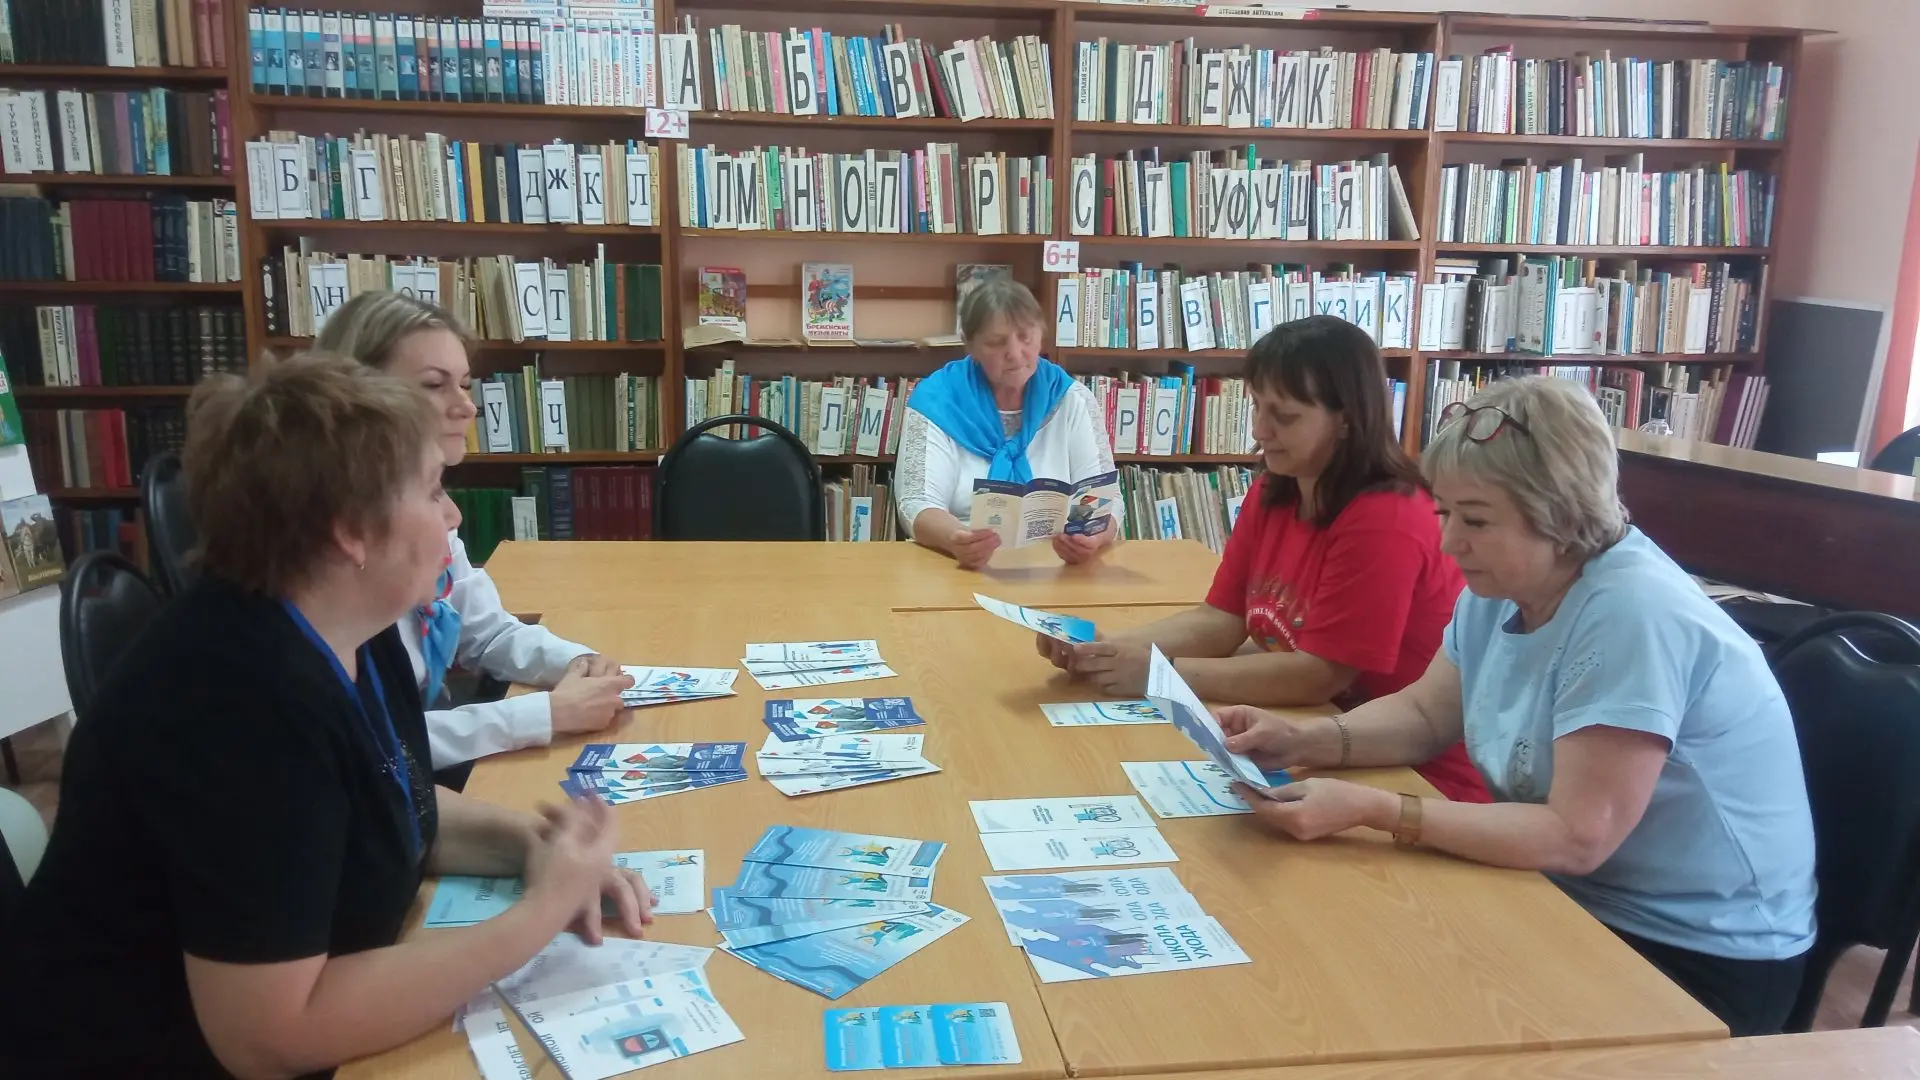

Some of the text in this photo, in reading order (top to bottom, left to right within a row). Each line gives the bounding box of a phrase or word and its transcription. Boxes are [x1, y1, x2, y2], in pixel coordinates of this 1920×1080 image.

[679, 39, 698, 104] А
[794, 45, 810, 109] Б
[891, 50, 912, 114] В
[950, 52, 968, 117] Г
[1134, 54, 1154, 119] Д
[1203, 60, 1222, 113] Е
[1228, 60, 1251, 115] Ж
[1276, 62, 1298, 122] И
[1309, 63, 1330, 123] К
[646, 113, 687, 134] 12+
[280, 159, 299, 191] Б
[358, 168, 376, 199] Г
[526, 171, 542, 202] Д
[547, 169, 569, 190] Ж
[584, 172, 602, 204] К
[630, 174, 648, 205] Л
[714, 161, 731, 222] Л
[795, 160, 812, 225] Н
[736, 163, 757, 224] М
[843, 166, 863, 228] О
[879, 168, 898, 228] П
[978, 169, 994, 229] Р
[1074, 170, 1093, 229] С
[1147, 175, 1163, 230] Т
[1210, 175, 1228, 232] У
[1227, 178, 1248, 234] Ф
[1266, 174, 1281, 225] Ч
[1289, 176, 1309, 227] Ш
[1337, 178, 1354, 229] Я
[1046, 245, 1077, 266] 6+
[325, 286, 345, 306] Н
[524, 284, 541, 316] С
[549, 290, 565, 320] Т
[1059, 294, 1074, 323] А
[1140, 298, 1154, 326] Б
[1185, 300, 1201, 327] В
[1356, 300, 1371, 327] И
[1388, 294, 1403, 323] К
[1254, 301, 1270, 329] Г
[488, 403, 503, 433] У
[548, 403, 563, 434] Ч
[822, 403, 841, 432] Л
[862, 407, 882, 437] М
[1120, 410, 1135, 436] Р
[1156, 409, 1170, 436] С
[1153, 924, 1192, 962] ШКОЛА
[1176, 924, 1213, 959] УХОДА
